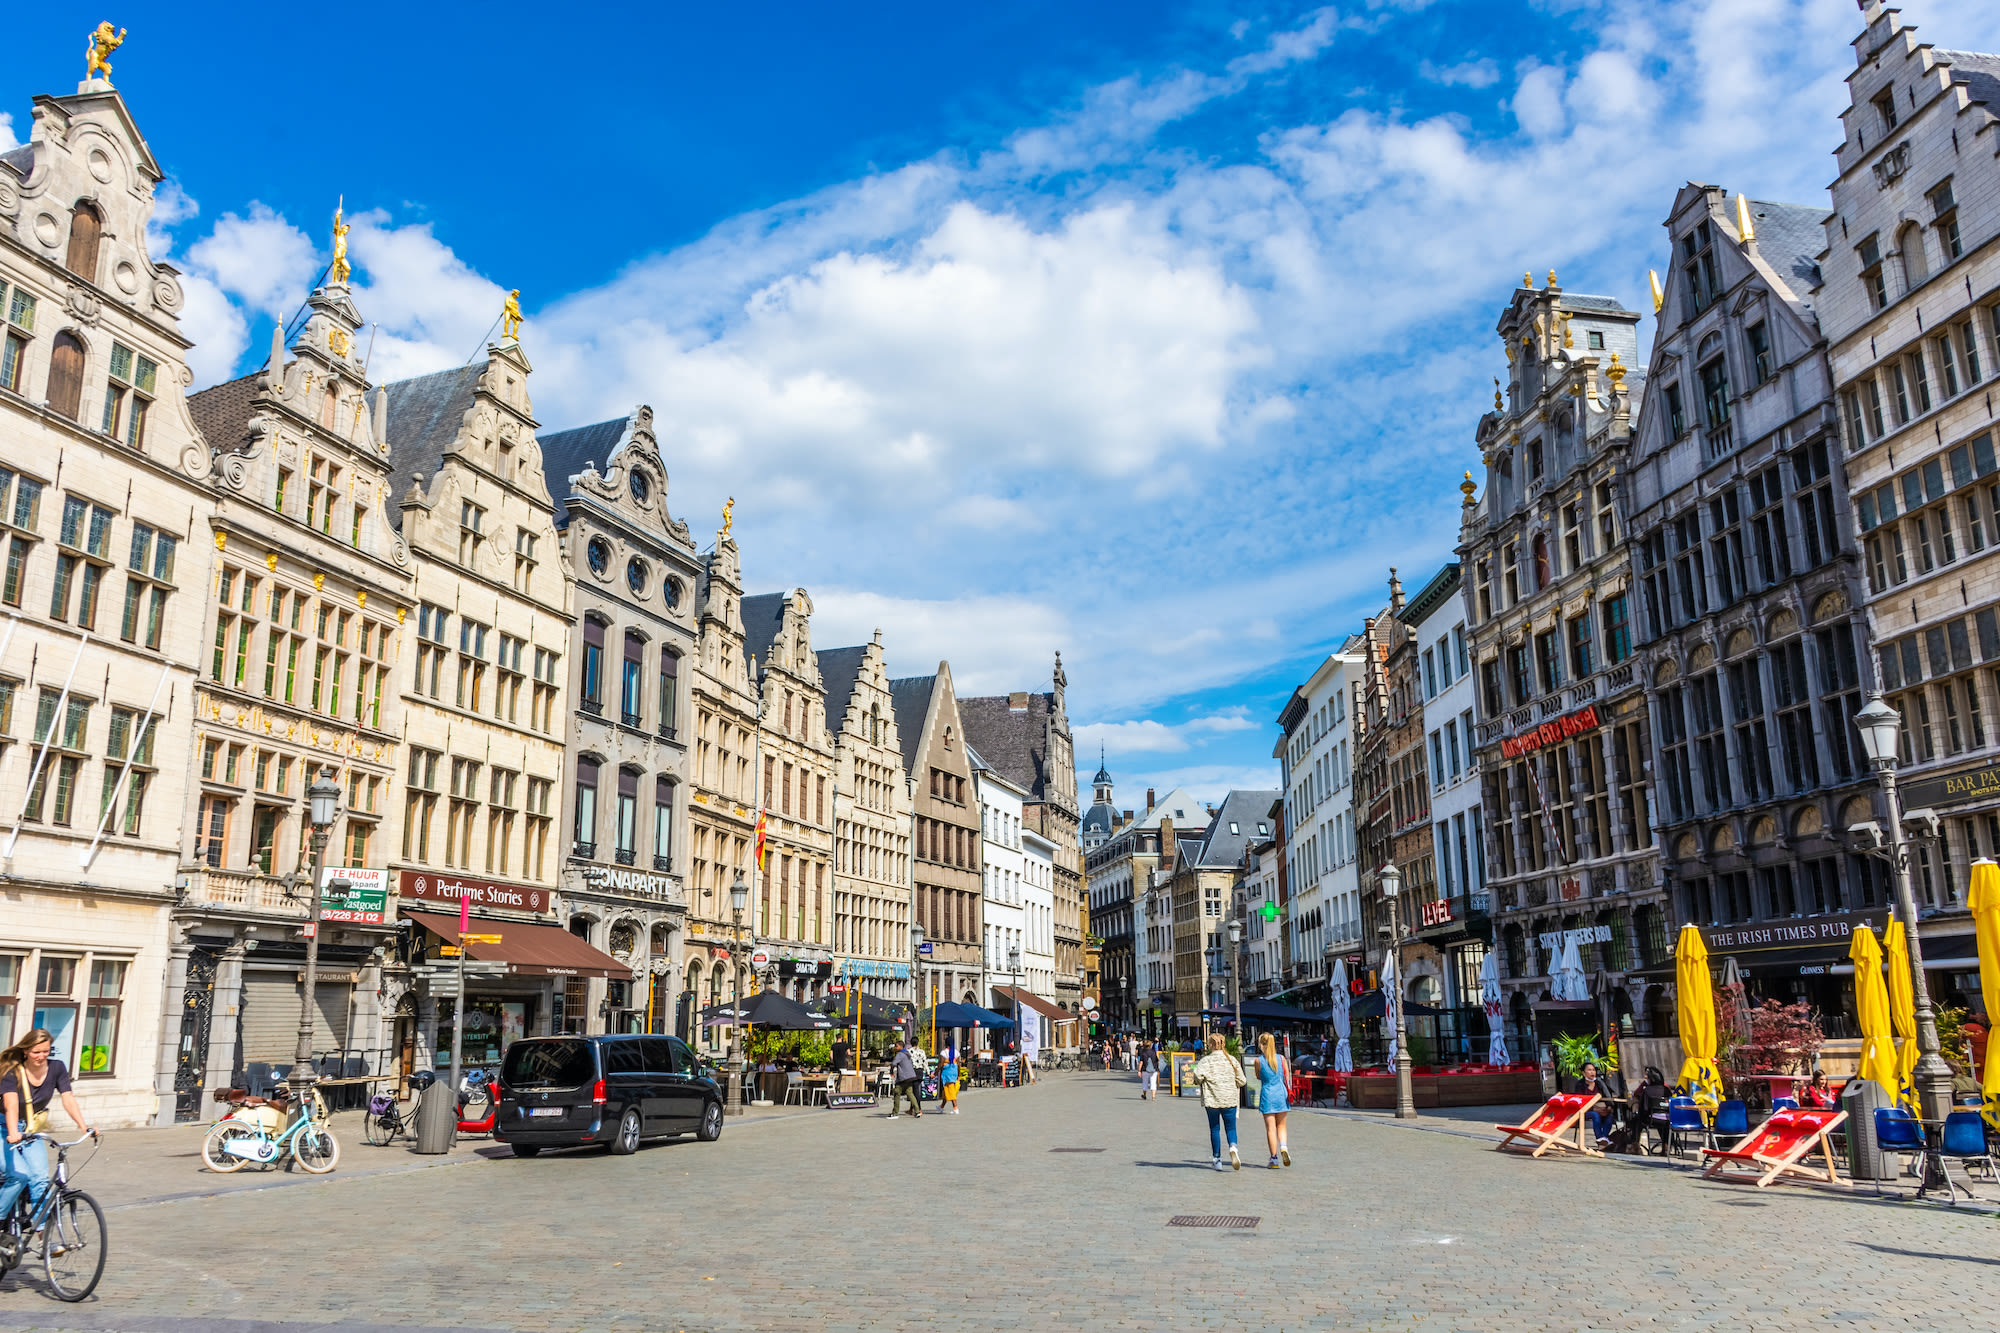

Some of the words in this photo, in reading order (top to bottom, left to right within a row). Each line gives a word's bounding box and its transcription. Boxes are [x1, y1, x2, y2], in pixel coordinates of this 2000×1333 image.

[1539, 723, 1562, 745] City
[1560, 705, 1598, 736] Hostel
[1946, 776, 1976, 794] BAR
[1980, 769, 2000, 787] PA
[333, 869, 345, 878] TE
[348, 870, 379, 880] HUUR
[588, 865, 673, 896] BONAPARTE
[436, 879, 484, 901] Perfume
[487, 885, 523, 906] Stories
[353, 911, 363, 920] 21
[366, 912, 379, 922] 02
[1422, 899, 1452, 927] LEVEL
[1539, 931, 1562, 949] STICKY
[1710, 932, 1735, 947] THE
[1737, 929, 1772, 945] IRISH
[1774, 924, 1817, 941] TIMES
[1820, 921, 1850, 938] PUB
[1800, 965, 1825, 975] GUINNESS
